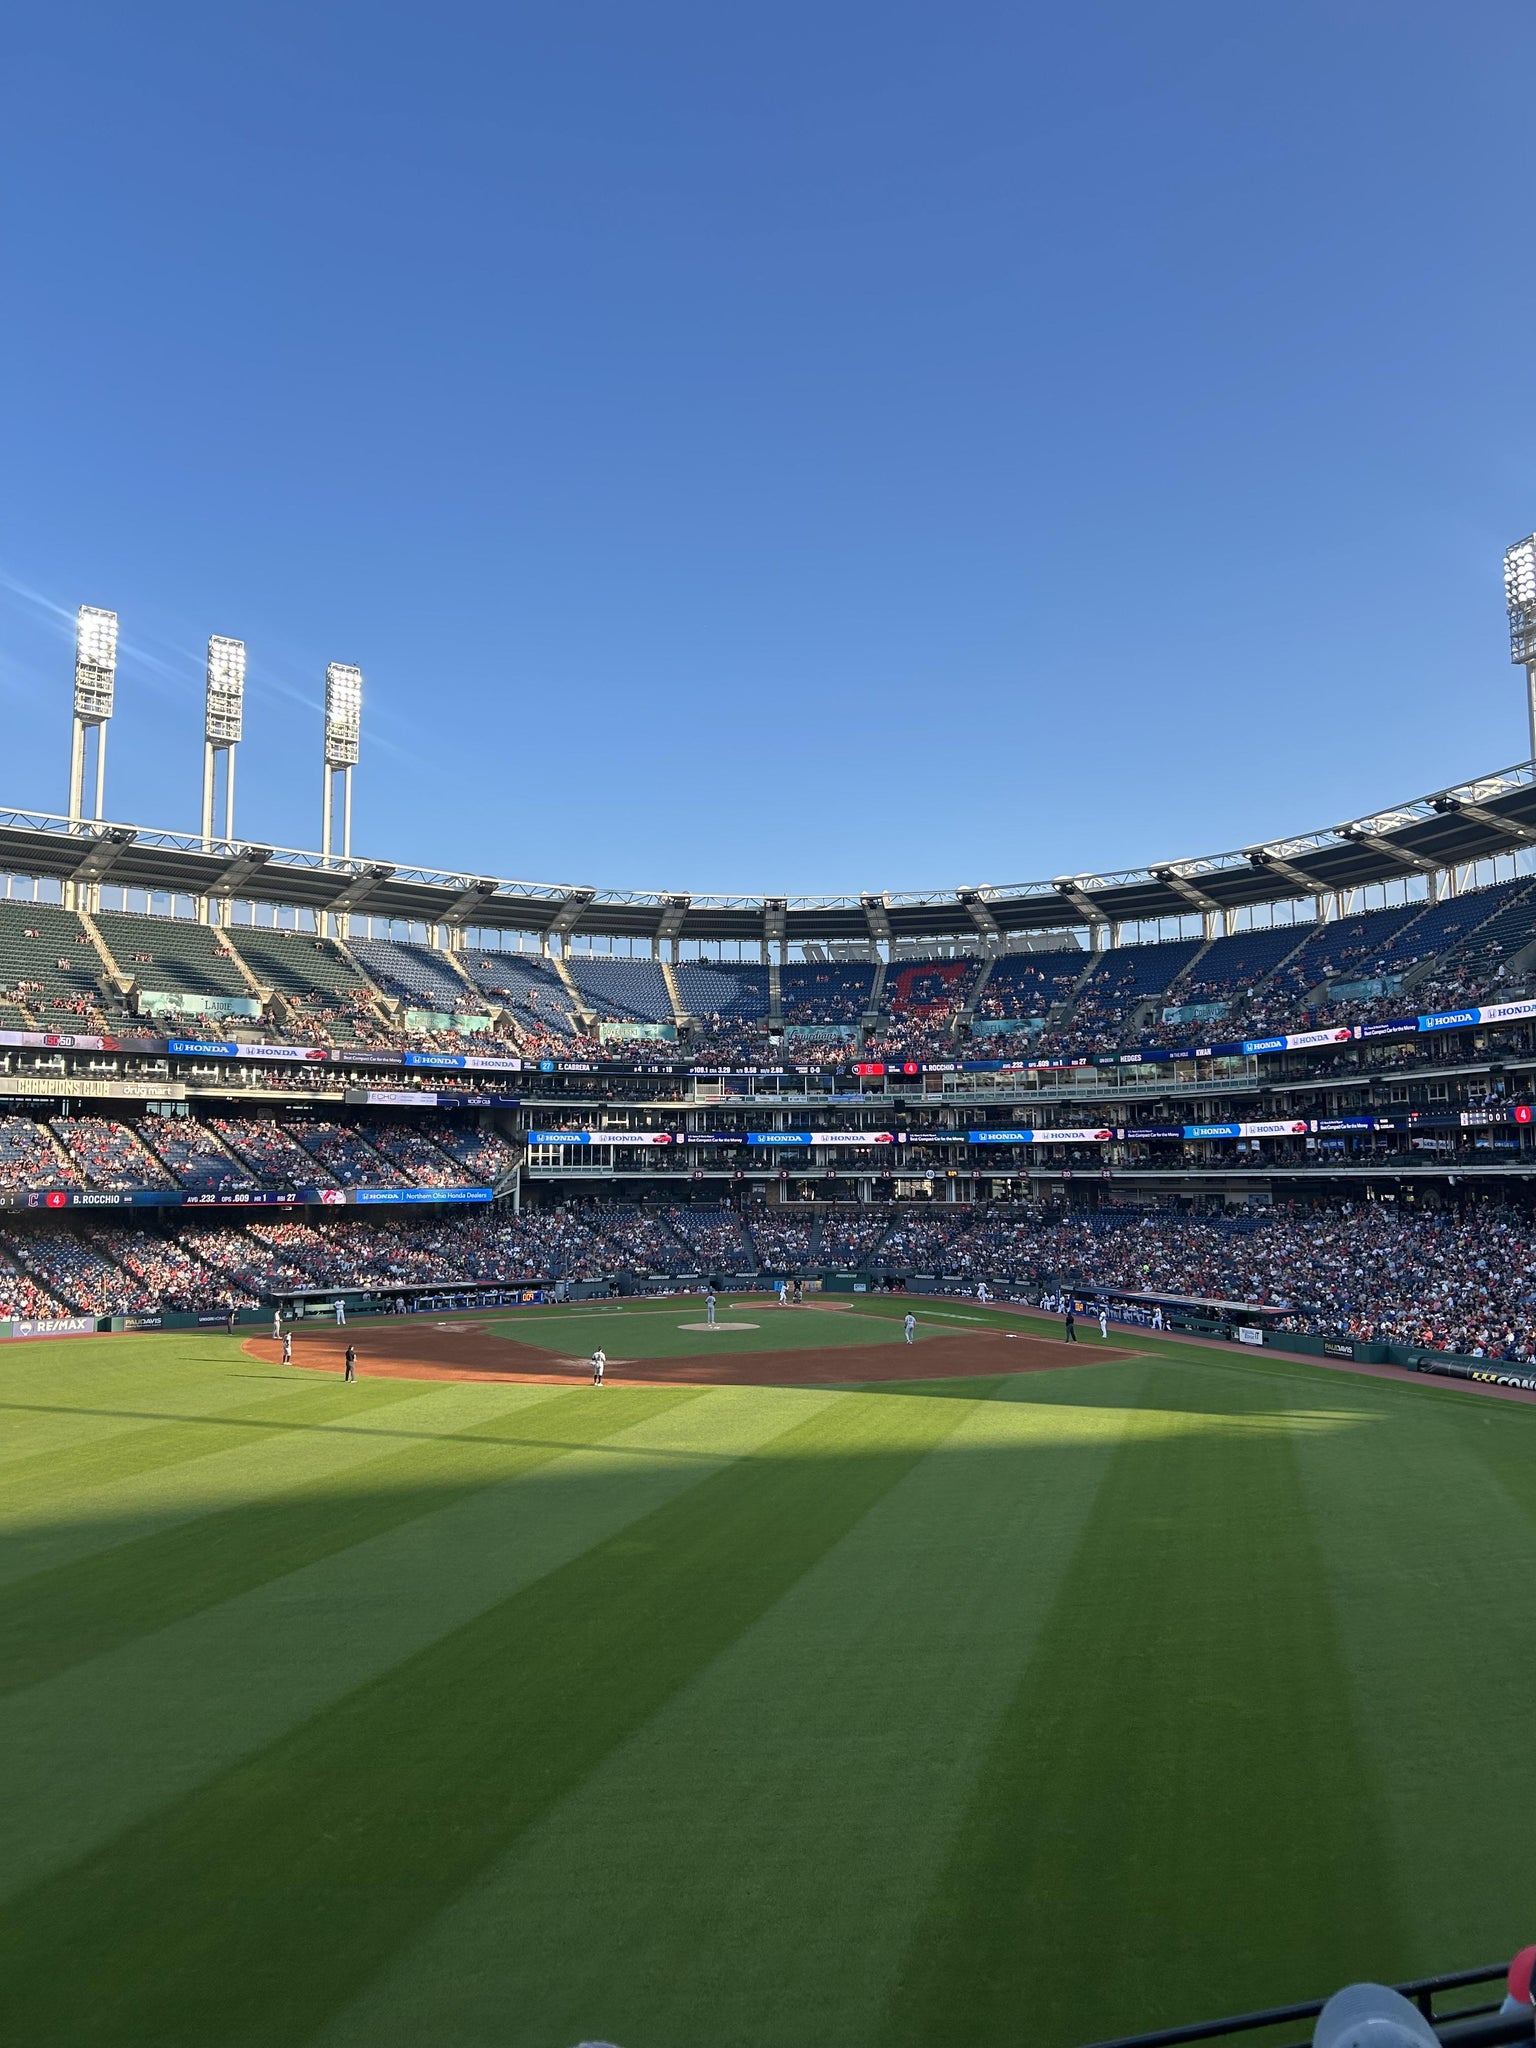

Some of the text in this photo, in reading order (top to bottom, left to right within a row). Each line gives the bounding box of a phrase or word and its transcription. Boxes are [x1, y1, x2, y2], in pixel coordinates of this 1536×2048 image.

[204, 1001, 232, 1011] LAJOIE
[1435, 1014, 1473, 1025] HONDA
[1300, 1034, 1329, 1044] HONDA
[184, 1044, 229, 1053] HONDA
[1253, 1040, 1282, 1050] HONDA
[1195, 1048, 1212, 1056] KWAN
[928, 1064, 955, 1072] ROCCHIO
[17, 1080, 110, 1095] CHAMPIONS CLUB
[123, 1085, 147, 1096] drug
[148, 1087, 172, 1095] mart
[1520, 1109, 1527, 1119] 4
[1257, 1125, 1285, 1133] HONDA
[53, 1195, 120, 1204] 4 B. ROCCHIO
[199, 1194, 216, 1203] .232
[232, 1194, 250, 1202] .609
[37, 1319, 87, 1332] RE/MAX
